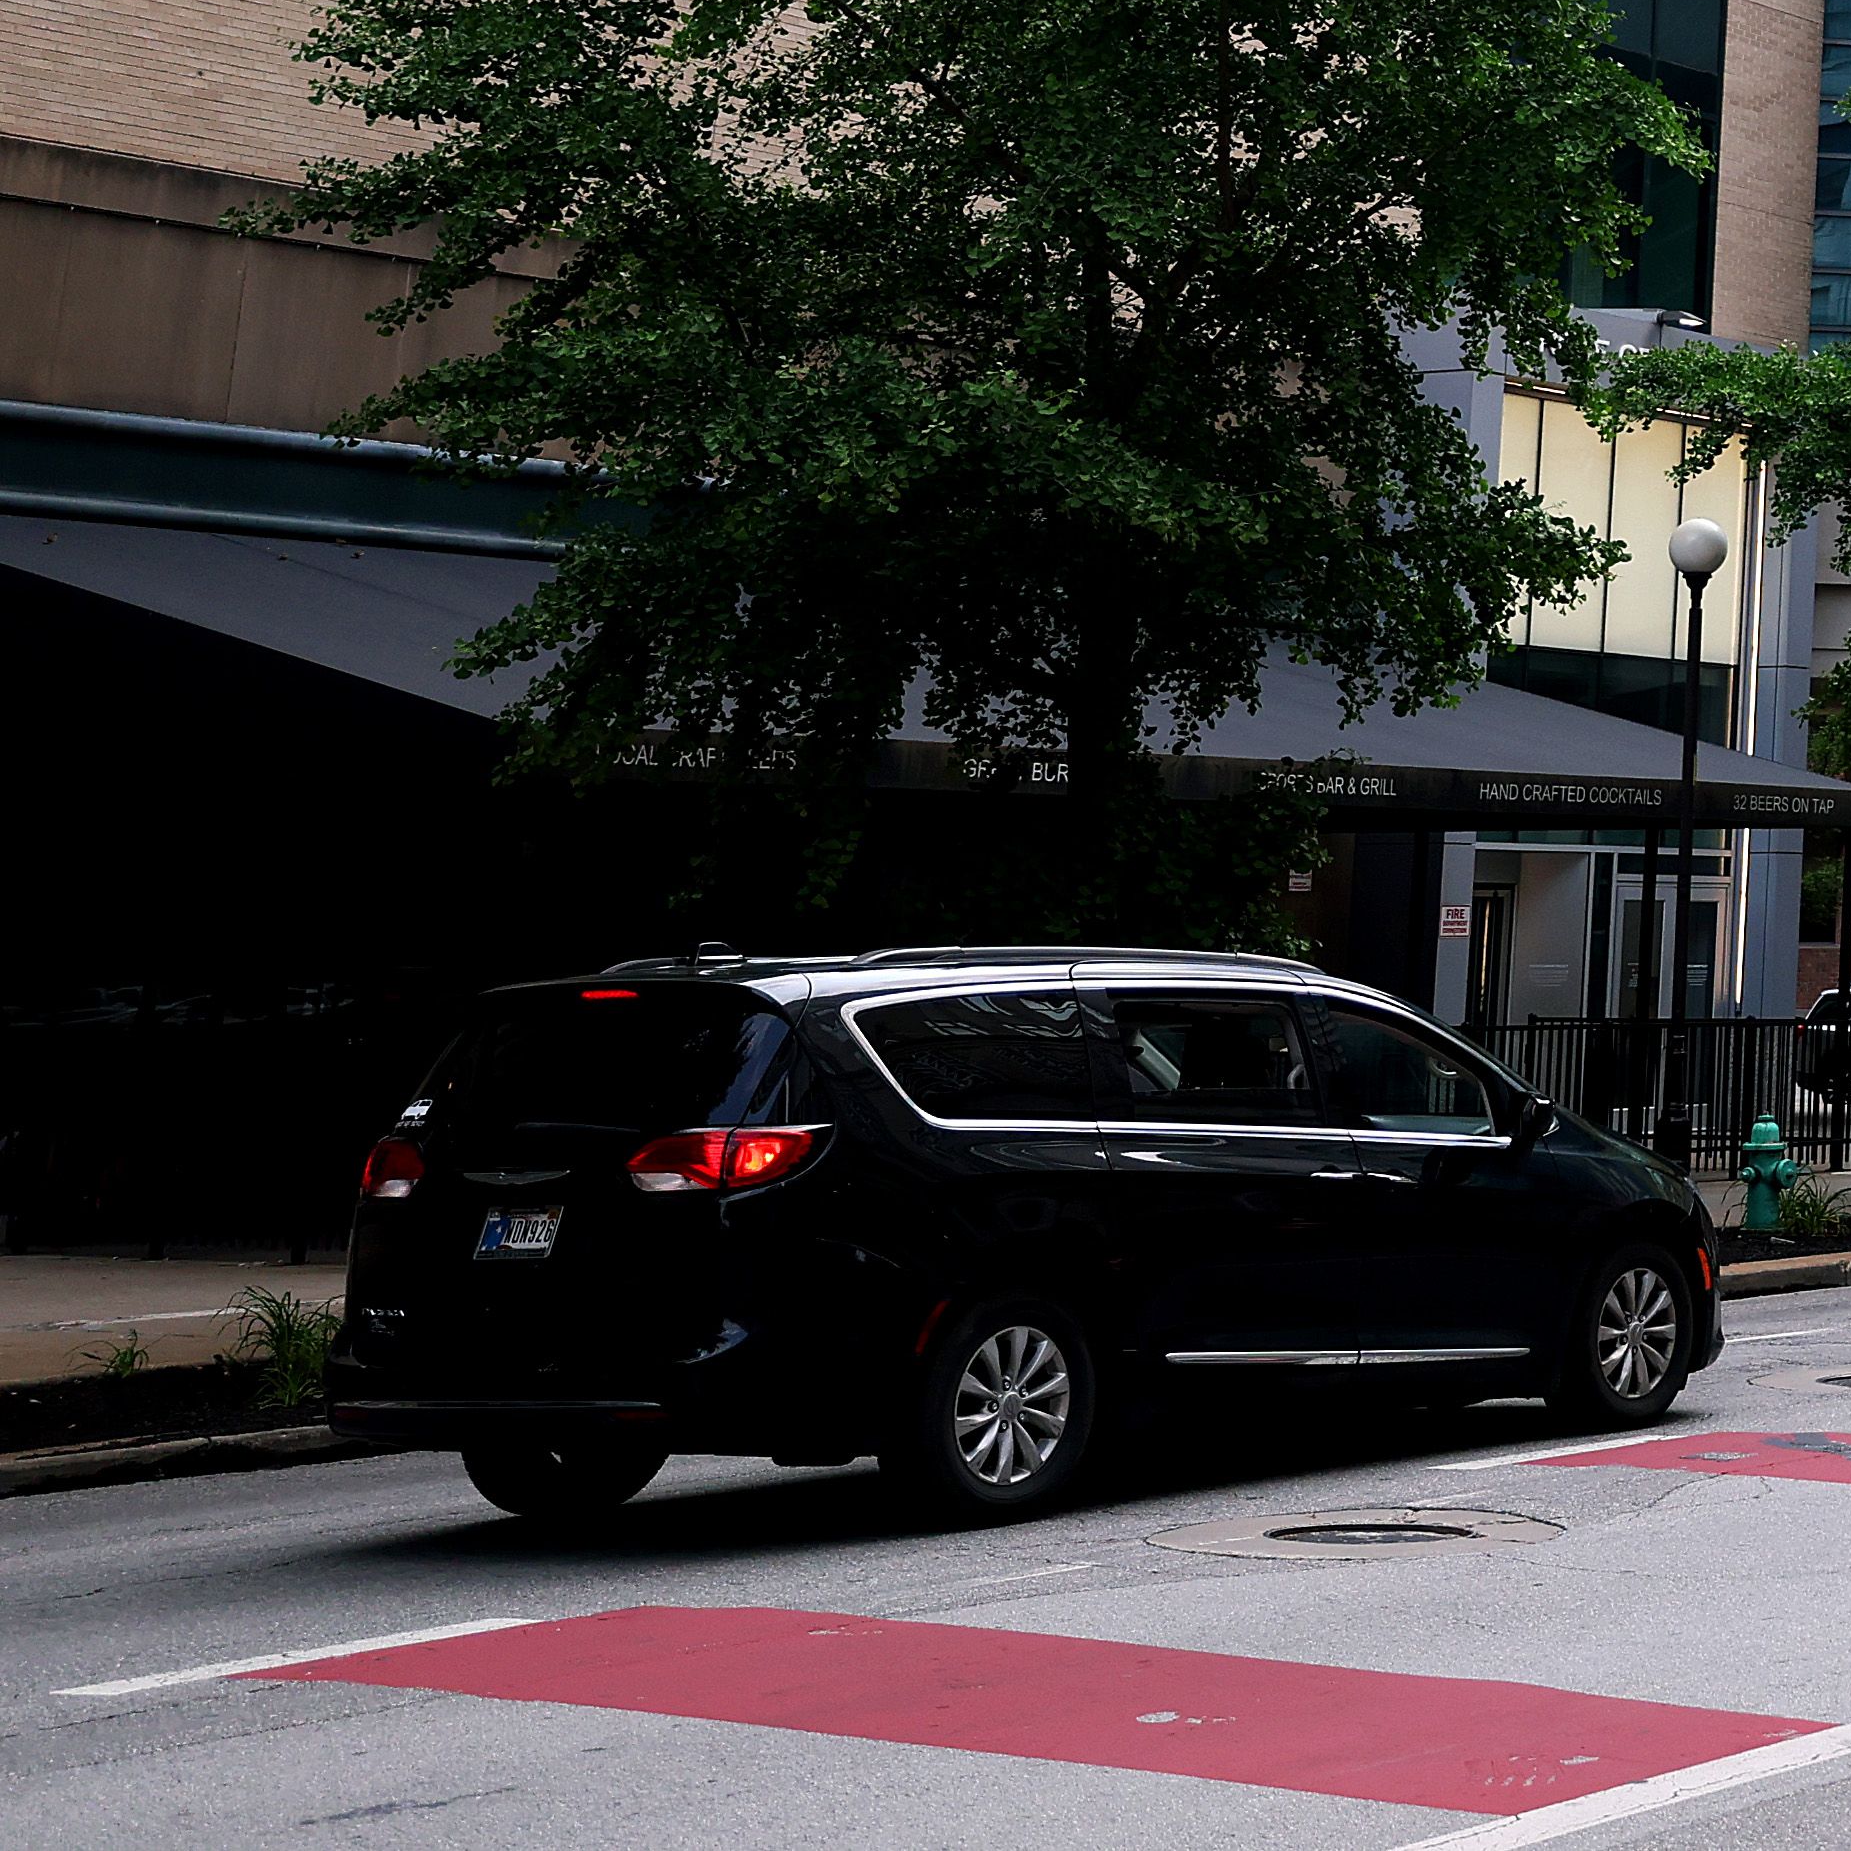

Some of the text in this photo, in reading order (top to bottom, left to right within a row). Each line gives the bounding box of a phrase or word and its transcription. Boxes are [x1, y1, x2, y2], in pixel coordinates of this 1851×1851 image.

[1347, 777, 1357, 795] &
[1360, 777, 1397, 796] GRILL
[1479, 782, 1662, 806] HAND CRAFTED COCKTAILS
[1733, 794, 1835, 815] 32 BEERS ON TAP
[1446, 908, 1466, 919] FIRE
